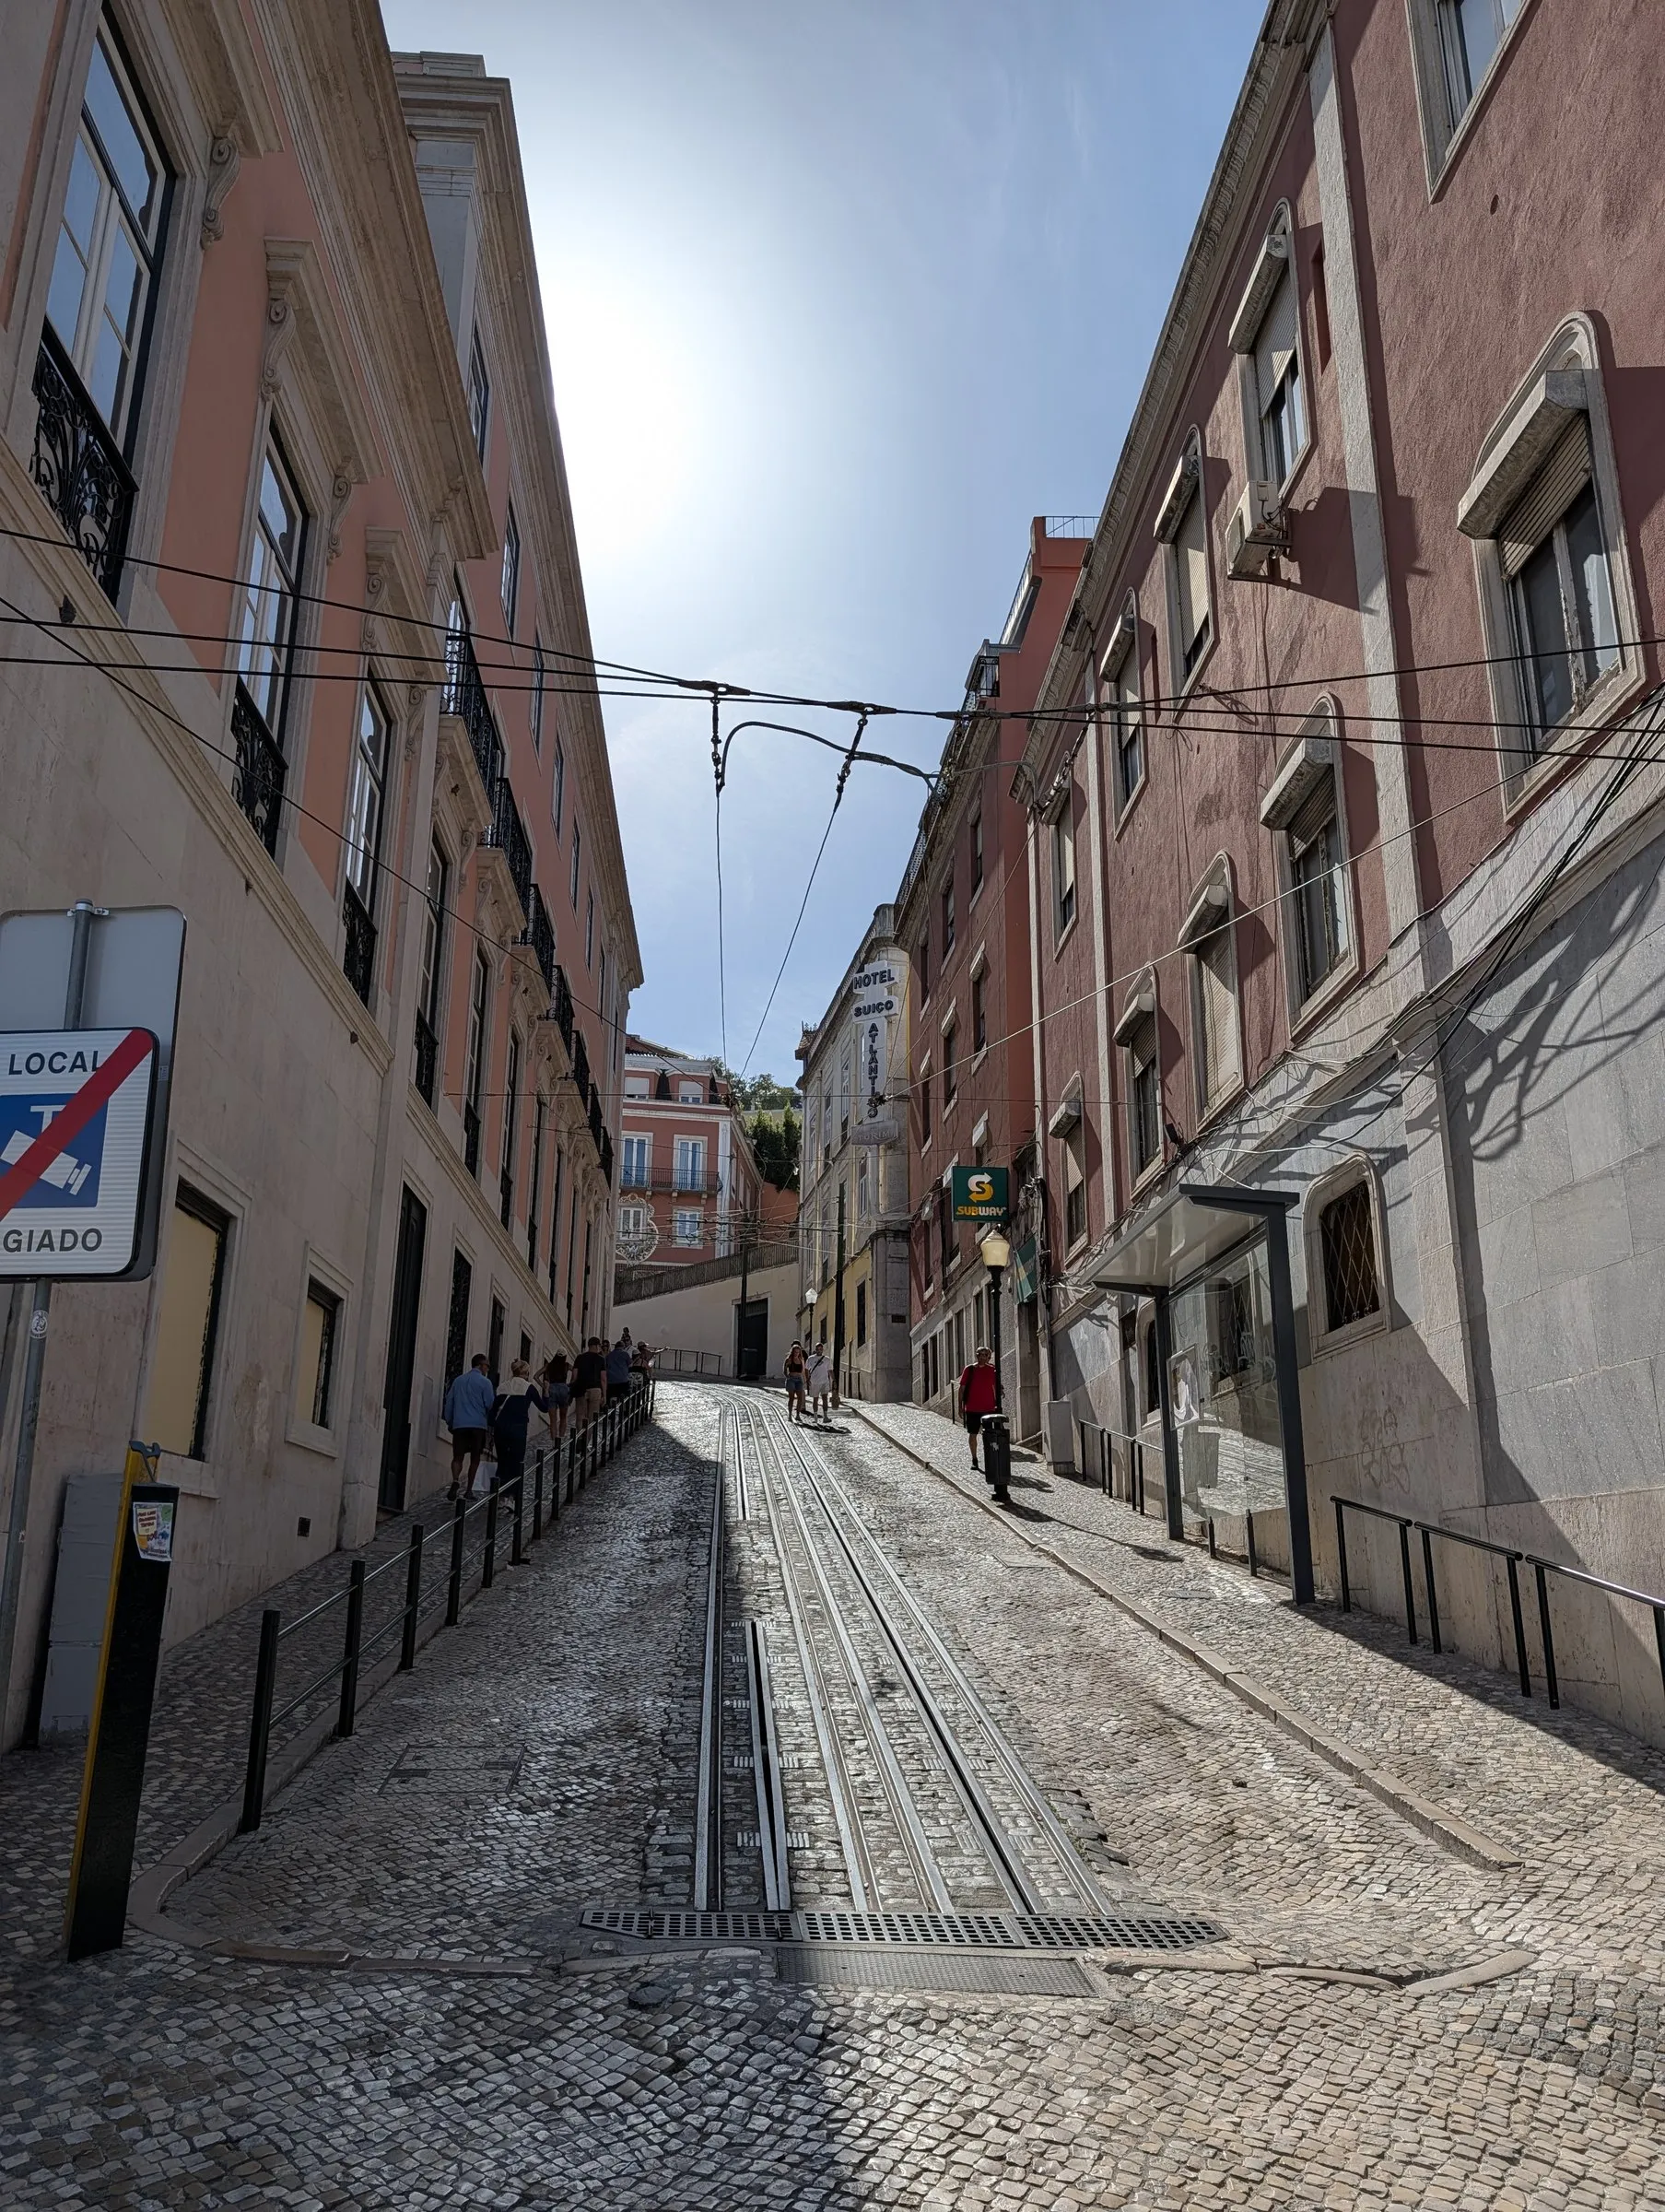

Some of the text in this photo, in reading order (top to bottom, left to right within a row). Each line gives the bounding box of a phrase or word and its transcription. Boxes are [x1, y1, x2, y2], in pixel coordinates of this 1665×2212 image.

[853, 969, 895, 989] HOTEL
[8, 1050, 102, 1076] LOCAL
[956, 1206, 1003, 1217] SUBWAY
